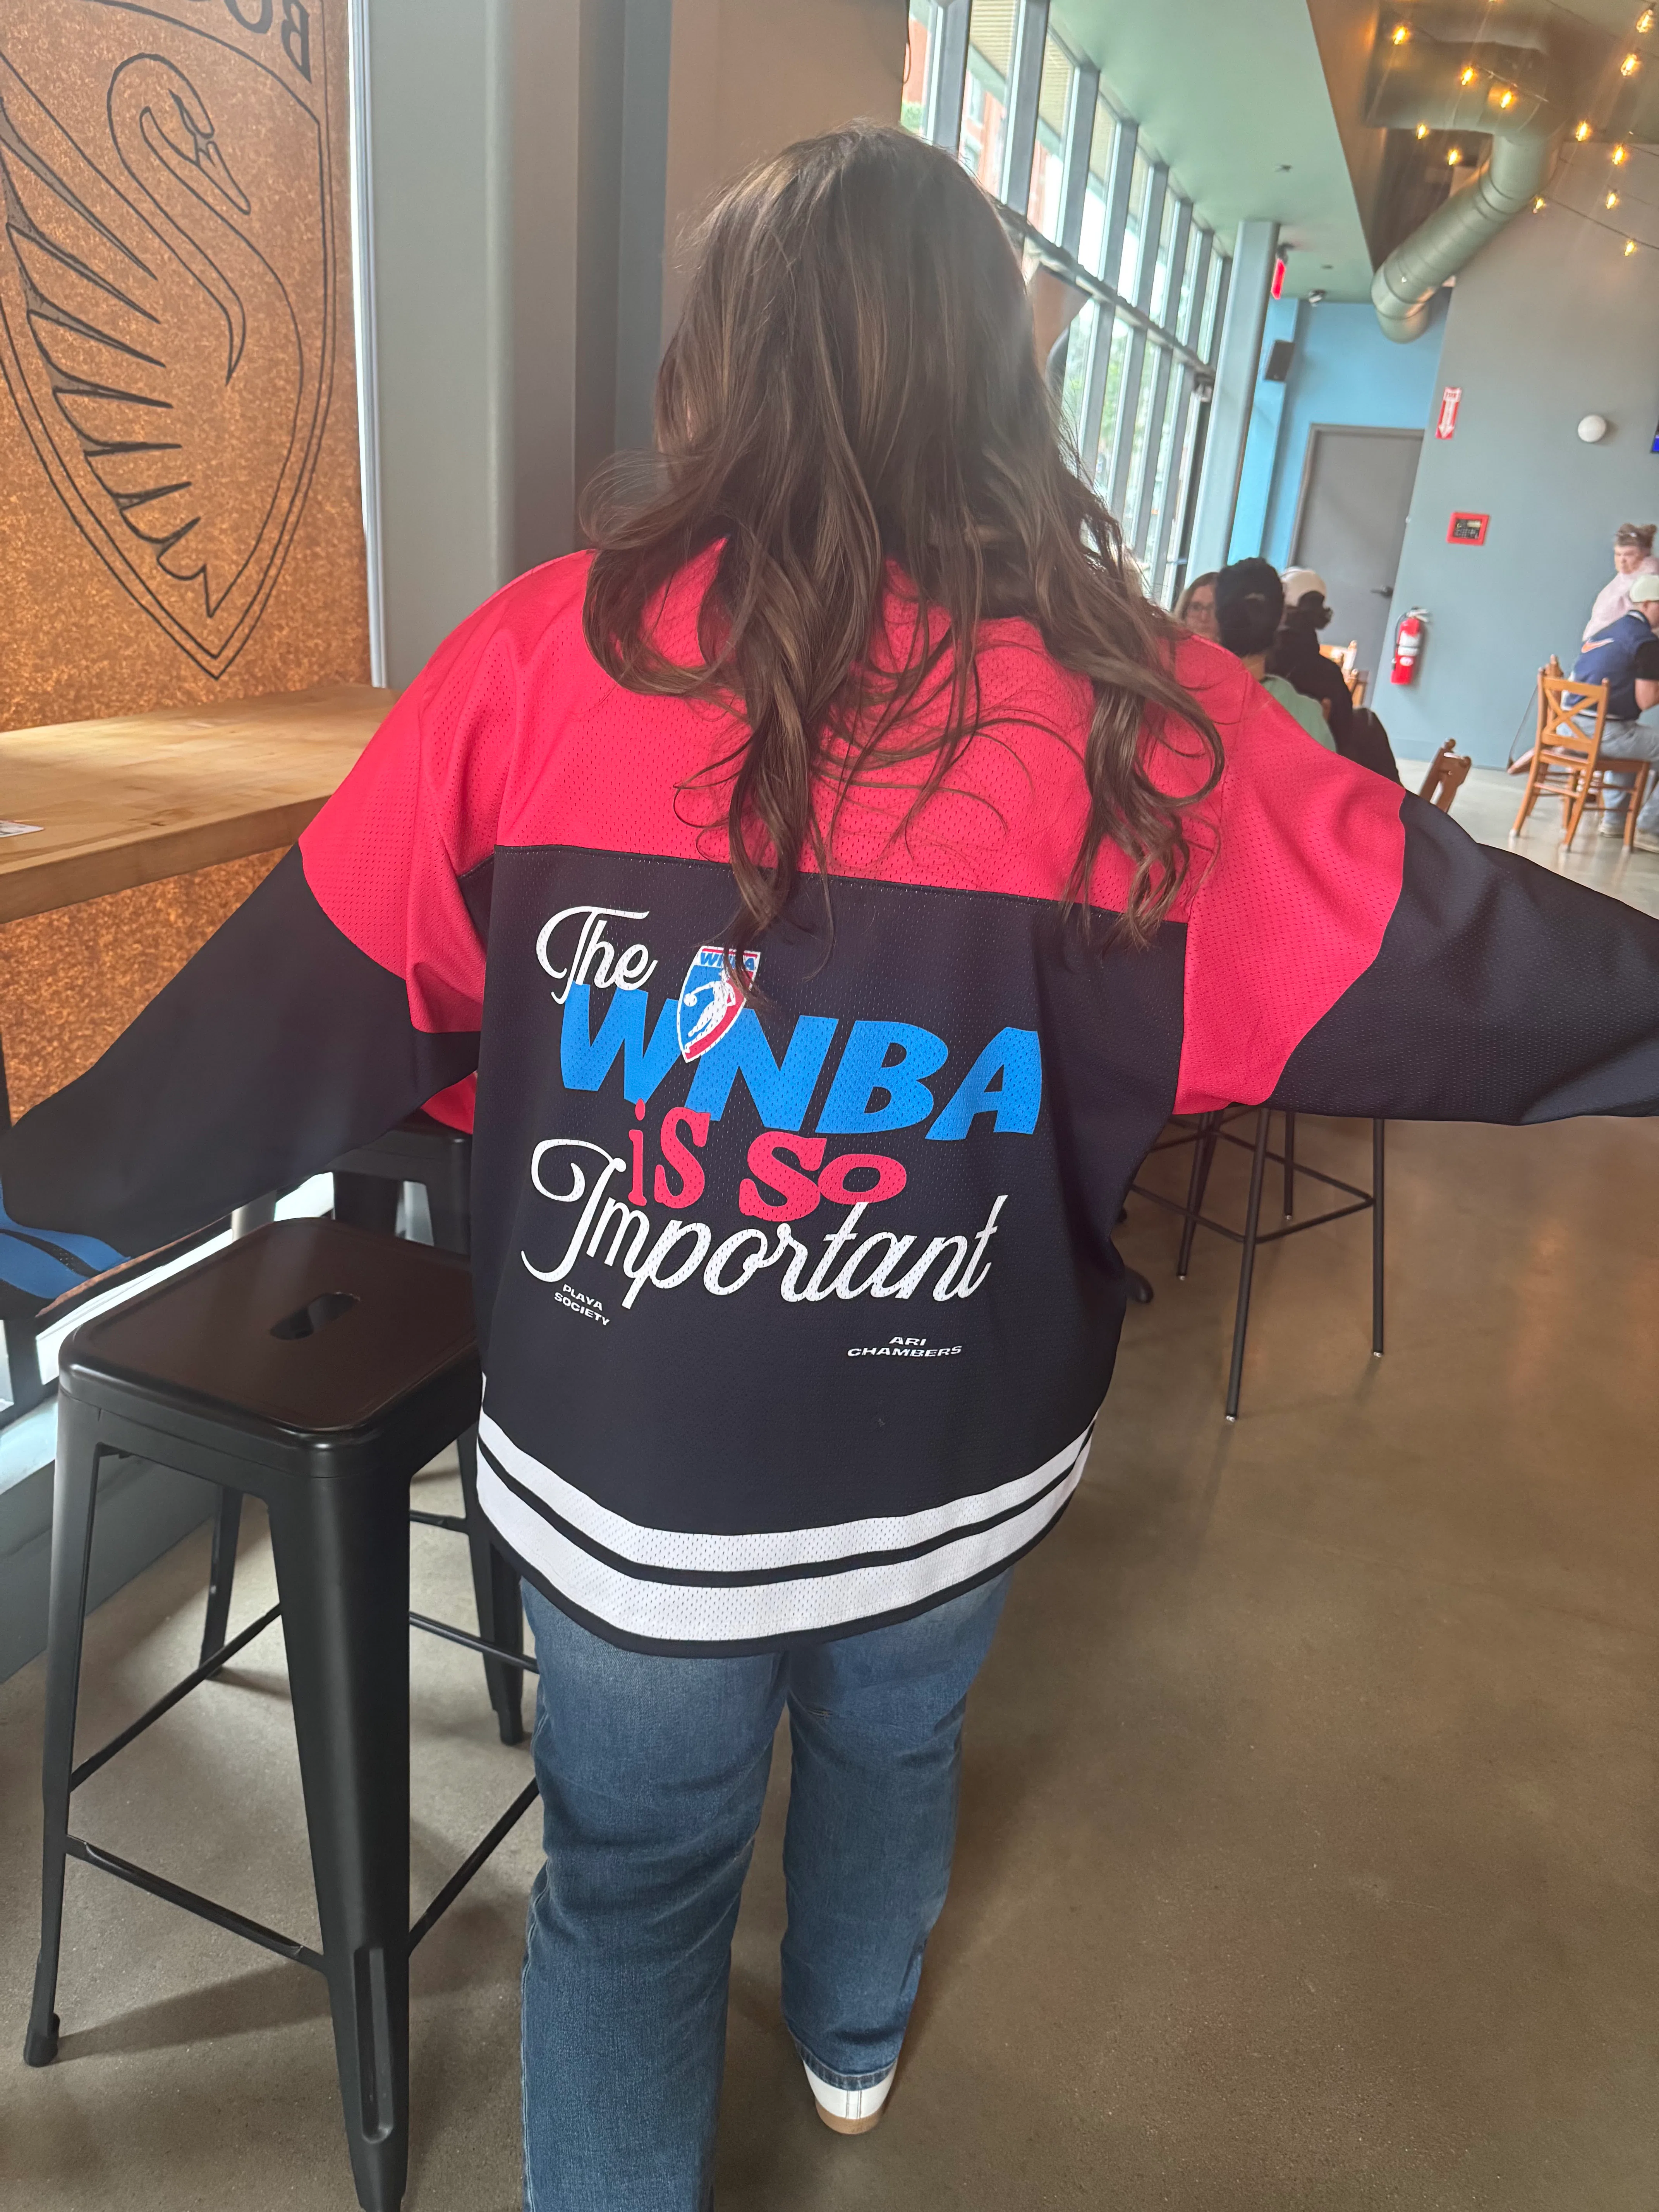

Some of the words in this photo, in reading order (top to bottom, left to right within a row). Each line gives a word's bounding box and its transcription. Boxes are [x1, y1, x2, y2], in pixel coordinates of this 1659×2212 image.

[536, 906, 658, 1005] The
[560, 981, 1042, 1141] WNBA
[521, 1139, 1008, 1309] Important
[554, 1292, 610, 1326] SOCIETY
[563, 1284, 603, 1311] PLAYA
[847, 1345, 962, 1357] CHAMBERS
[889, 1337, 927, 1346] ARI
